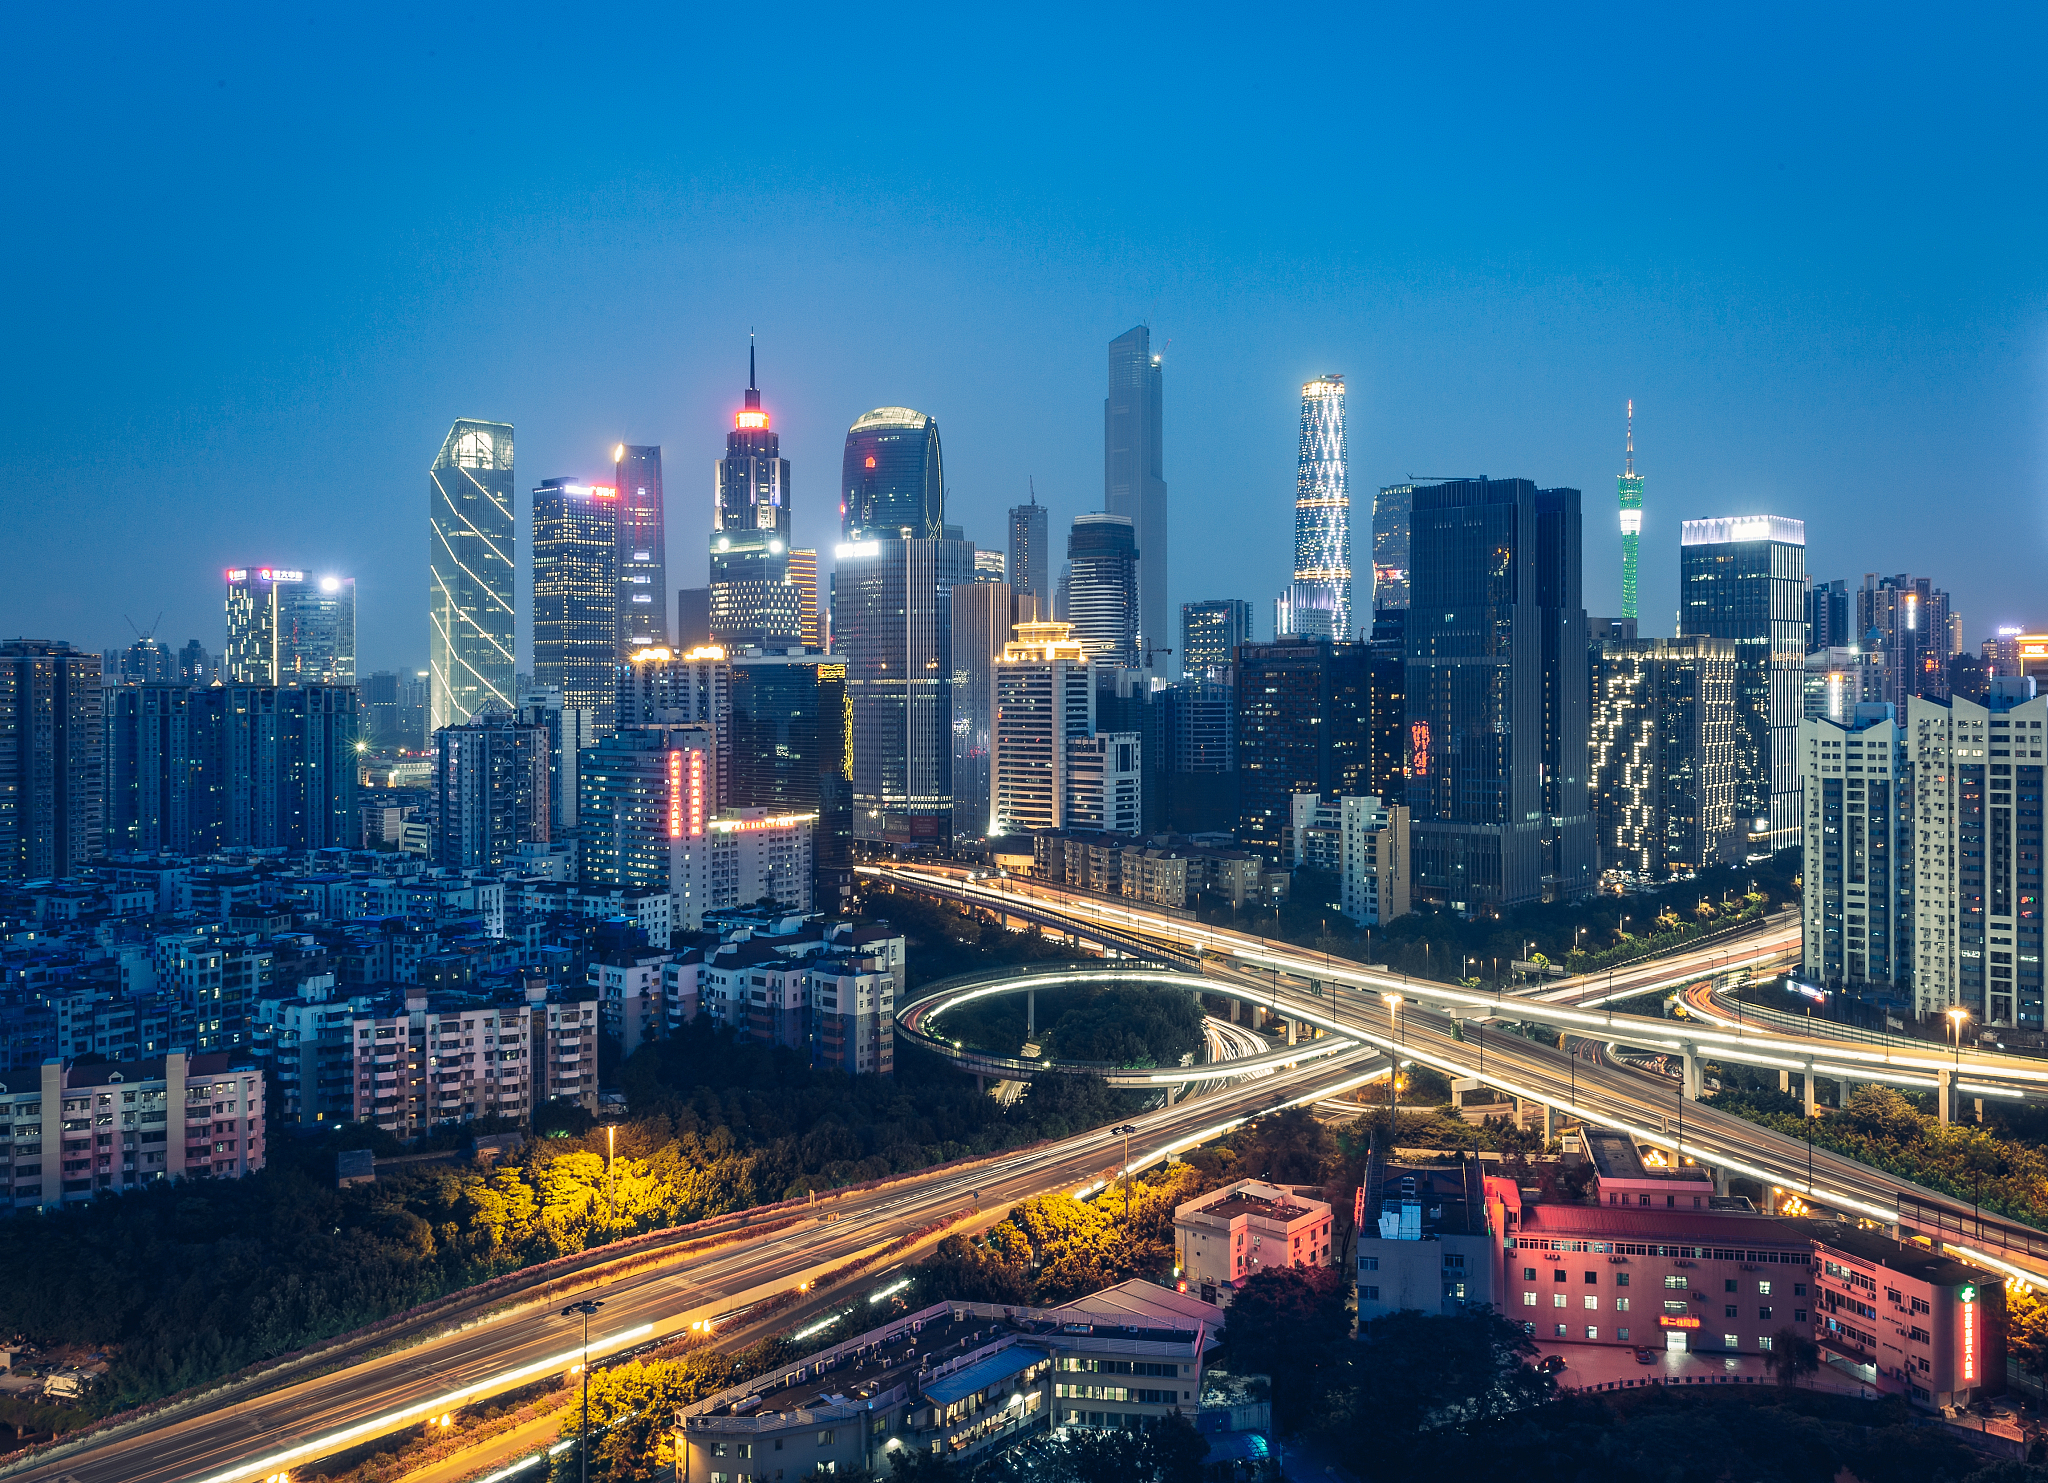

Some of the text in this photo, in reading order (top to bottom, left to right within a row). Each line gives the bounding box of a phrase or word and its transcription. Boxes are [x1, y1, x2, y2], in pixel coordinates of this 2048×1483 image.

[670, 751, 680, 837] 广州市第十二人民医院
